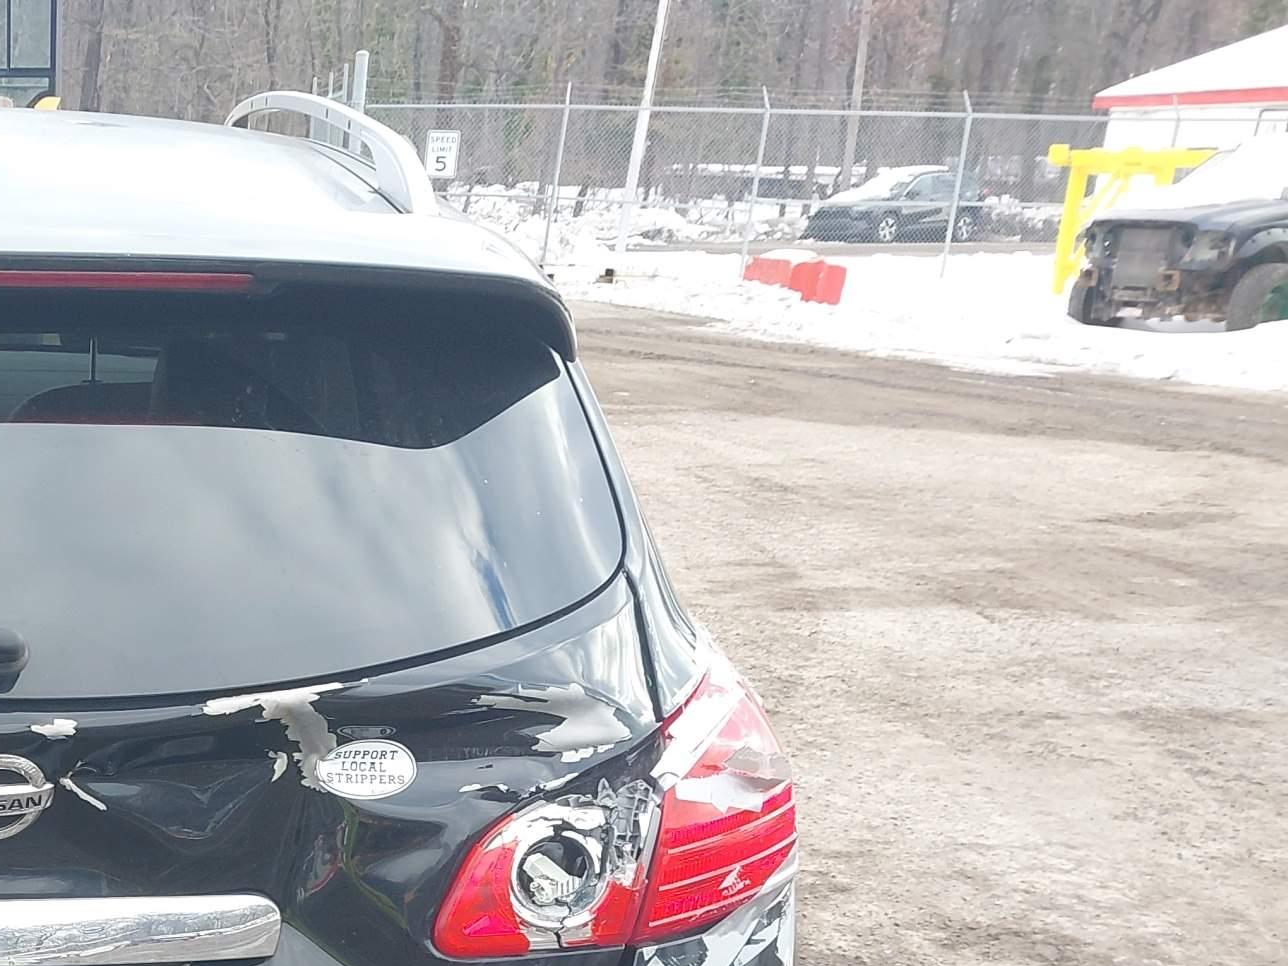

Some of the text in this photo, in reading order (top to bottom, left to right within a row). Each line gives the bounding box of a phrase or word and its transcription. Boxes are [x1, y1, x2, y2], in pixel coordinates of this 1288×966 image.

[435, 156, 447, 172] 5
[334, 750, 399, 760] SUPPORT
[341, 761, 387, 773] LOCAL
[326, 772, 406, 785] STRIPPERS
